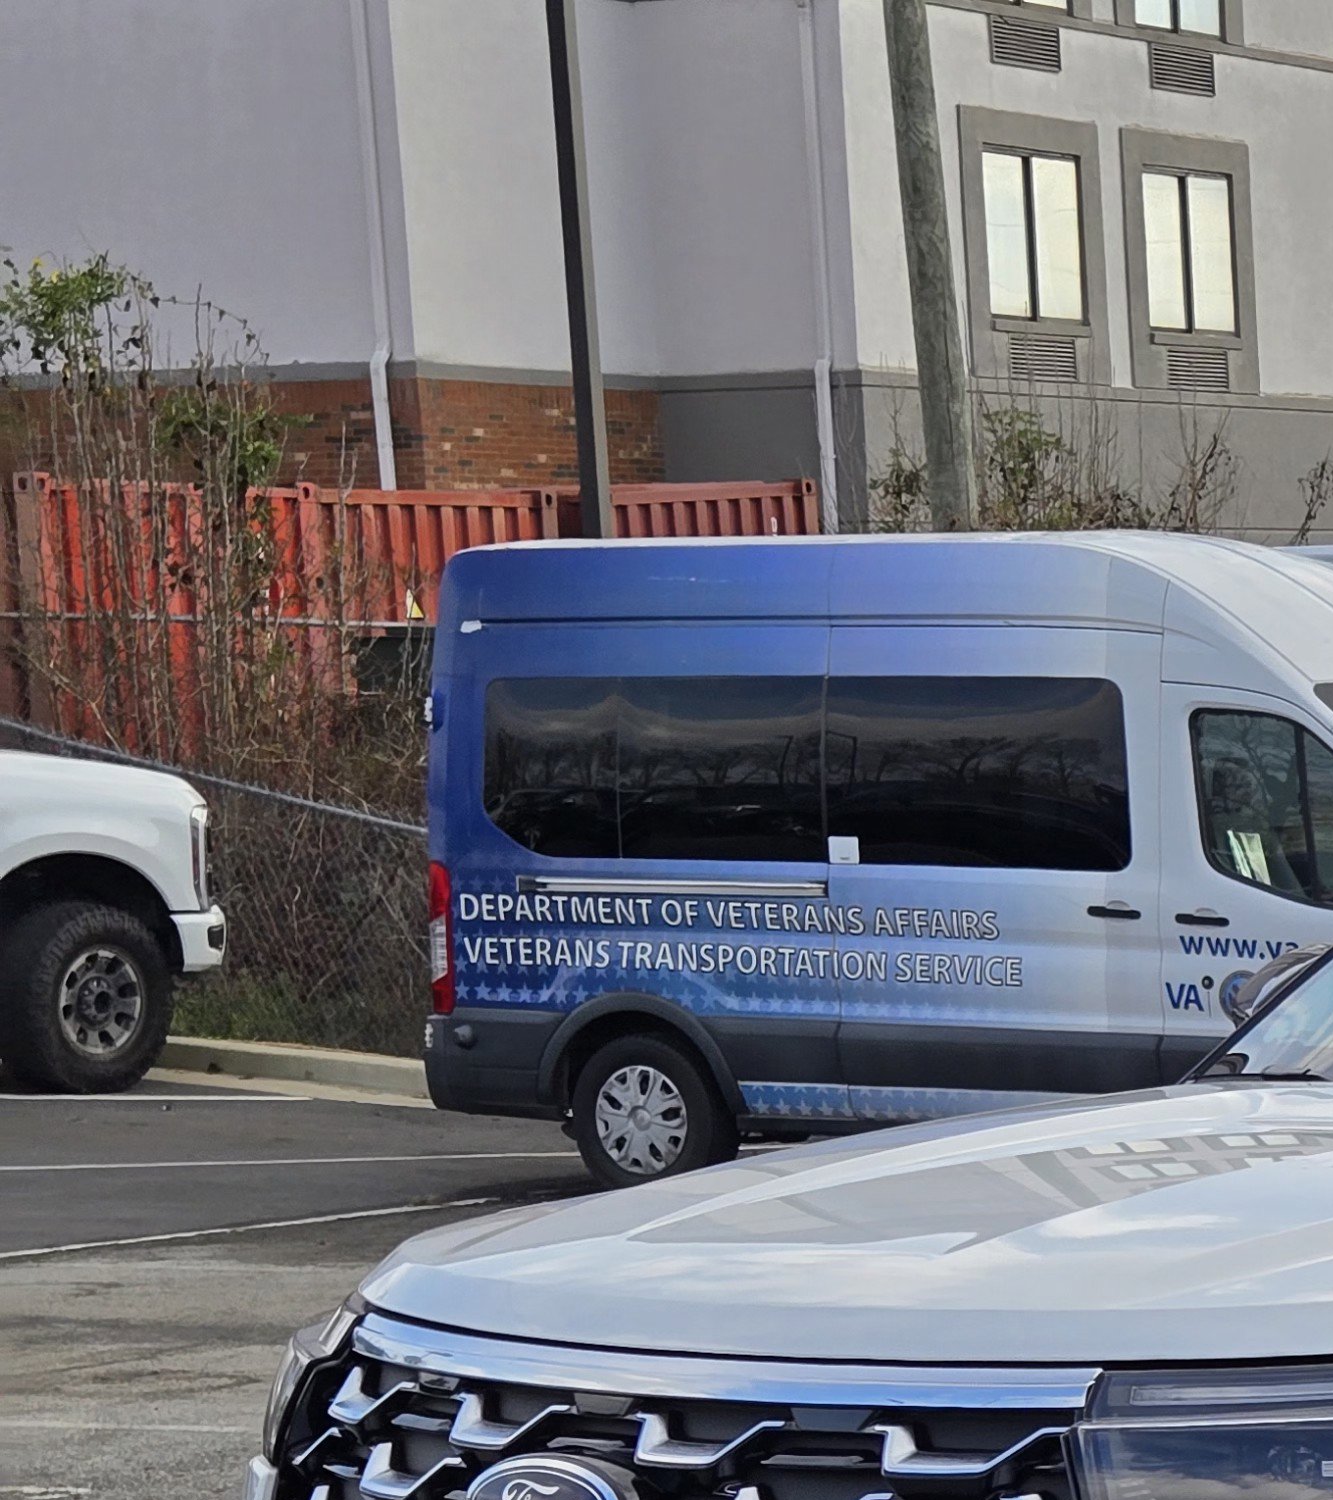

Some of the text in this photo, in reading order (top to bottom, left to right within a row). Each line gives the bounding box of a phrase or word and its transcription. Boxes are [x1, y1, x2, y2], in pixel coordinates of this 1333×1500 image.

[459, 893, 1001, 941] DEPARTMENT OF VETERANS AFFAIRS
[463, 936, 1023, 987] VETERANS TRANSPORTATION SERVICE
[1165, 981, 1205, 1012] VA
